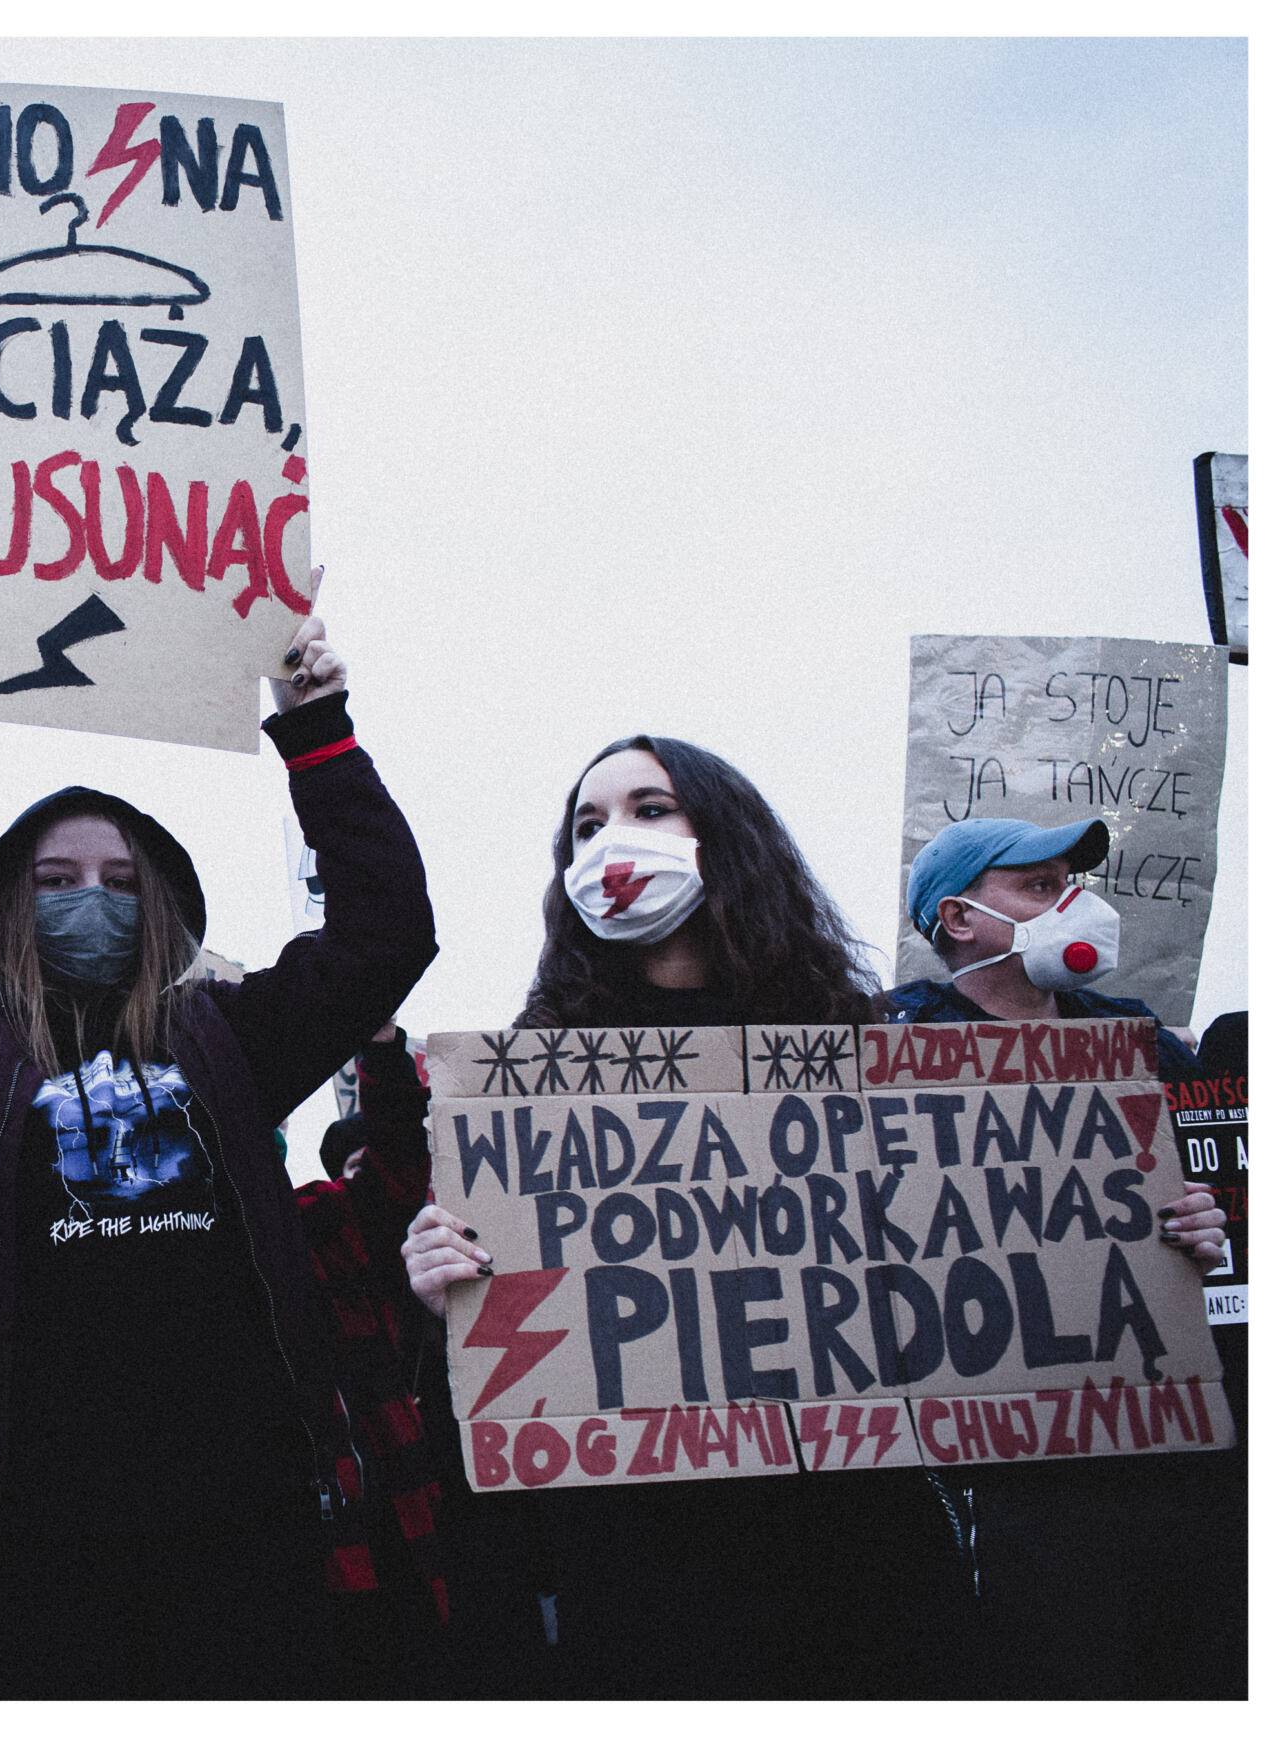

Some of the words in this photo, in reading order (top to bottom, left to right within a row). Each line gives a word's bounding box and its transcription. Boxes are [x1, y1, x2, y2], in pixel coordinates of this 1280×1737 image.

[946, 671, 1006, 736] JA
[1045, 671, 1181, 747] STOJĘ
[944, 756, 1006, 822] JA
[1037, 755, 1192, 820] TAŃCZĘ
[1067, 850, 1202, 907] ALCZĘ
[452, 1101, 749, 1198] WŁADZA
[769, 1084, 1163, 1180] OPĘTANA!
[1187, 1137, 1219, 1173] DO
[49, 1217, 94, 1246] RIDE
[96, 1214, 133, 1239] THE
[139, 1210, 215, 1234] LIGHTNING
[584, 1243, 1168, 1411] PIERDOLĄ
[470, 1398, 617, 1488] BÓG
